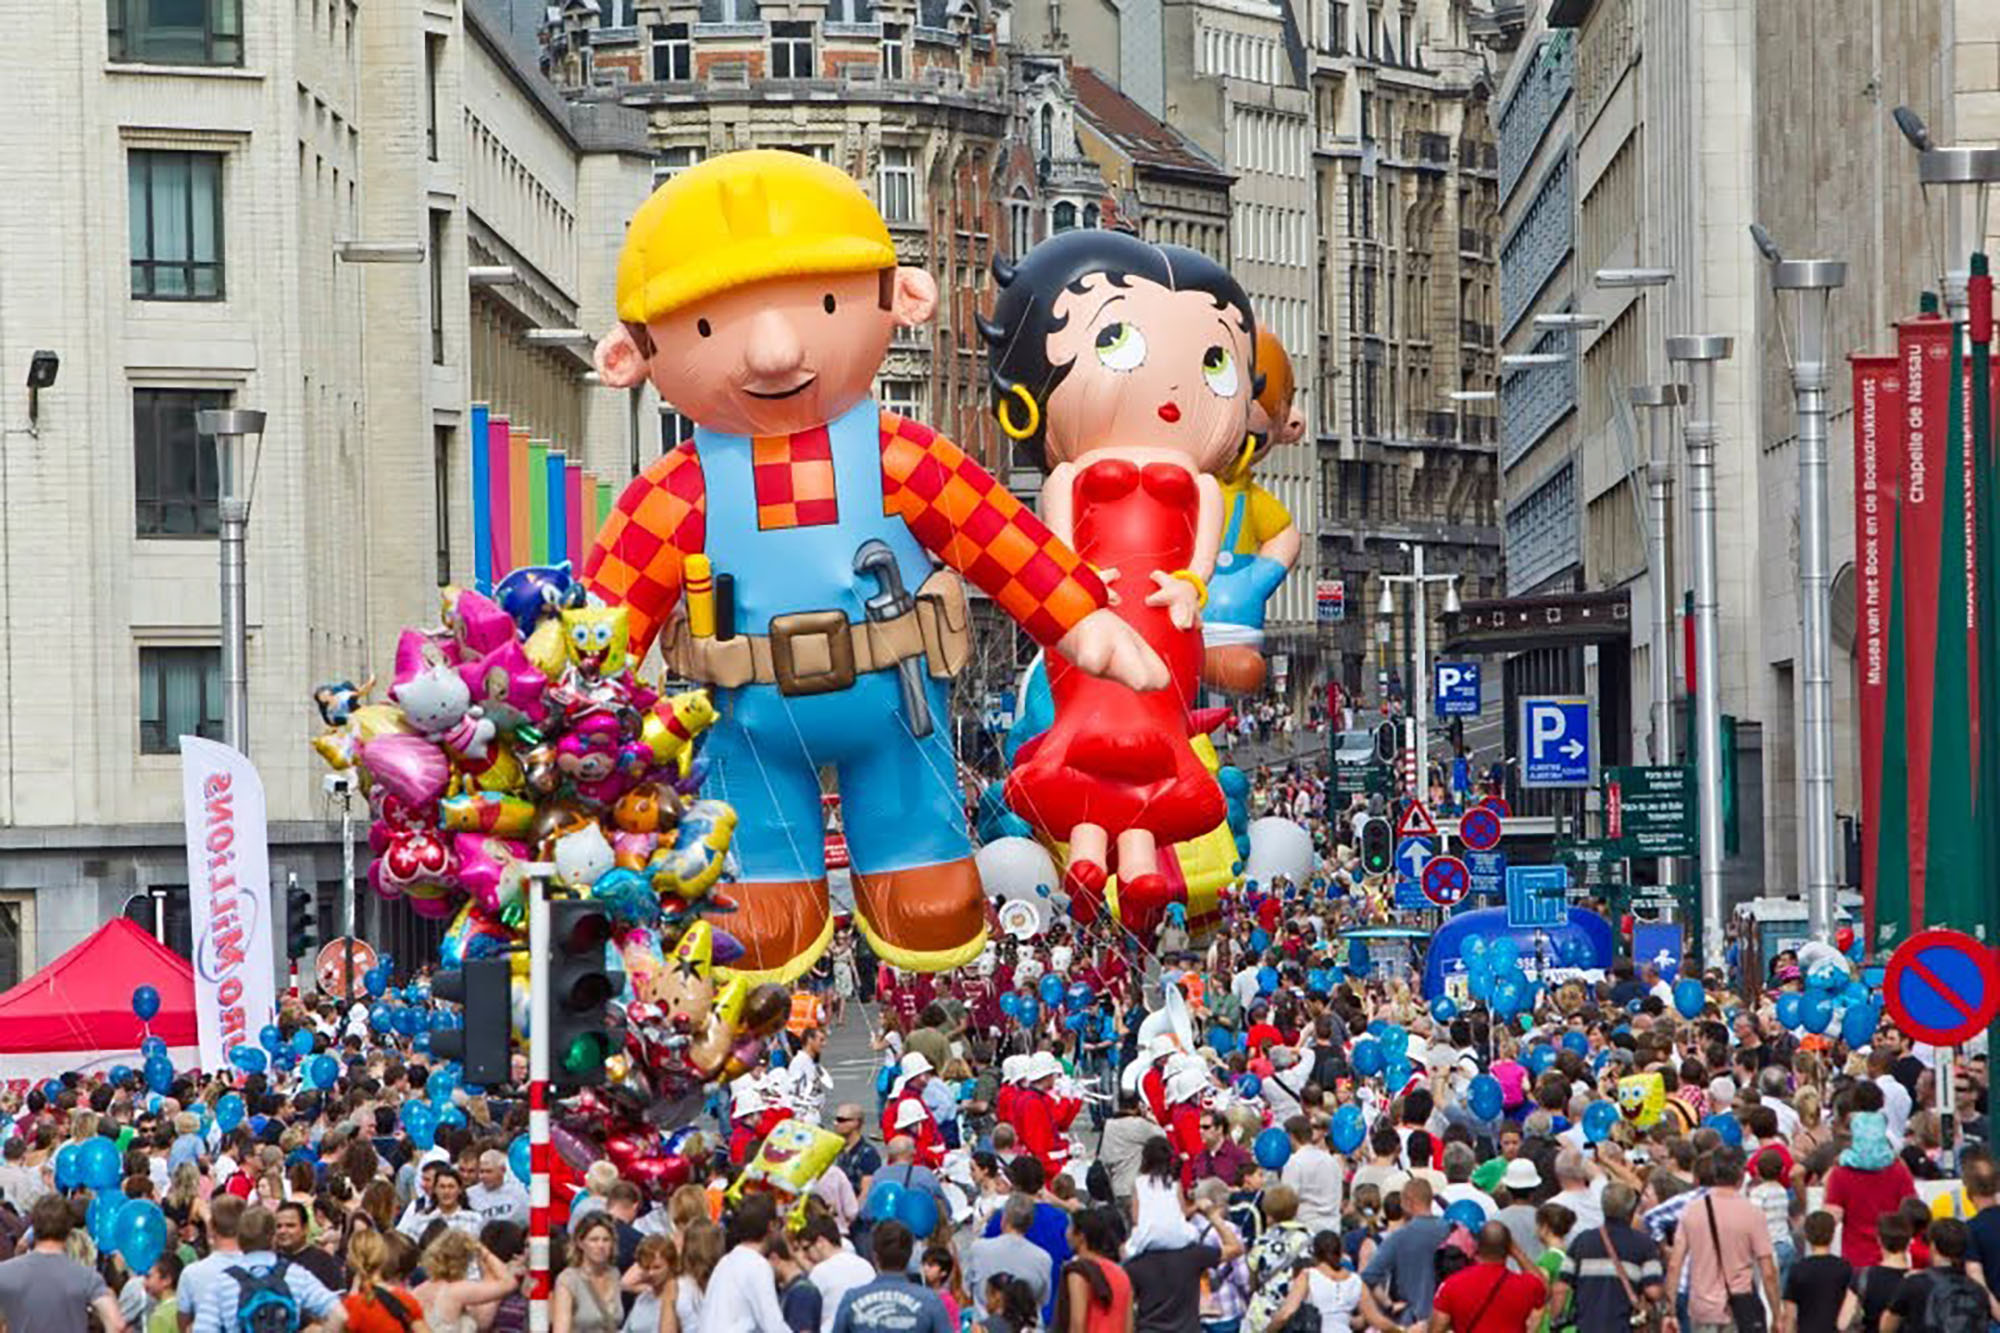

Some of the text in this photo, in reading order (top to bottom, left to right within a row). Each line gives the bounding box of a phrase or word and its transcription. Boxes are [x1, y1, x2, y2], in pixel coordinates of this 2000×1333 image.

[1907, 344, 1926, 503] Chapelle de Nassau
[1861, 377, 1881, 685] Musea van het Boek en de Boekdrukkunst
[1439, 668, 1461, 697] P
[1533, 707, 1566, 759] P
